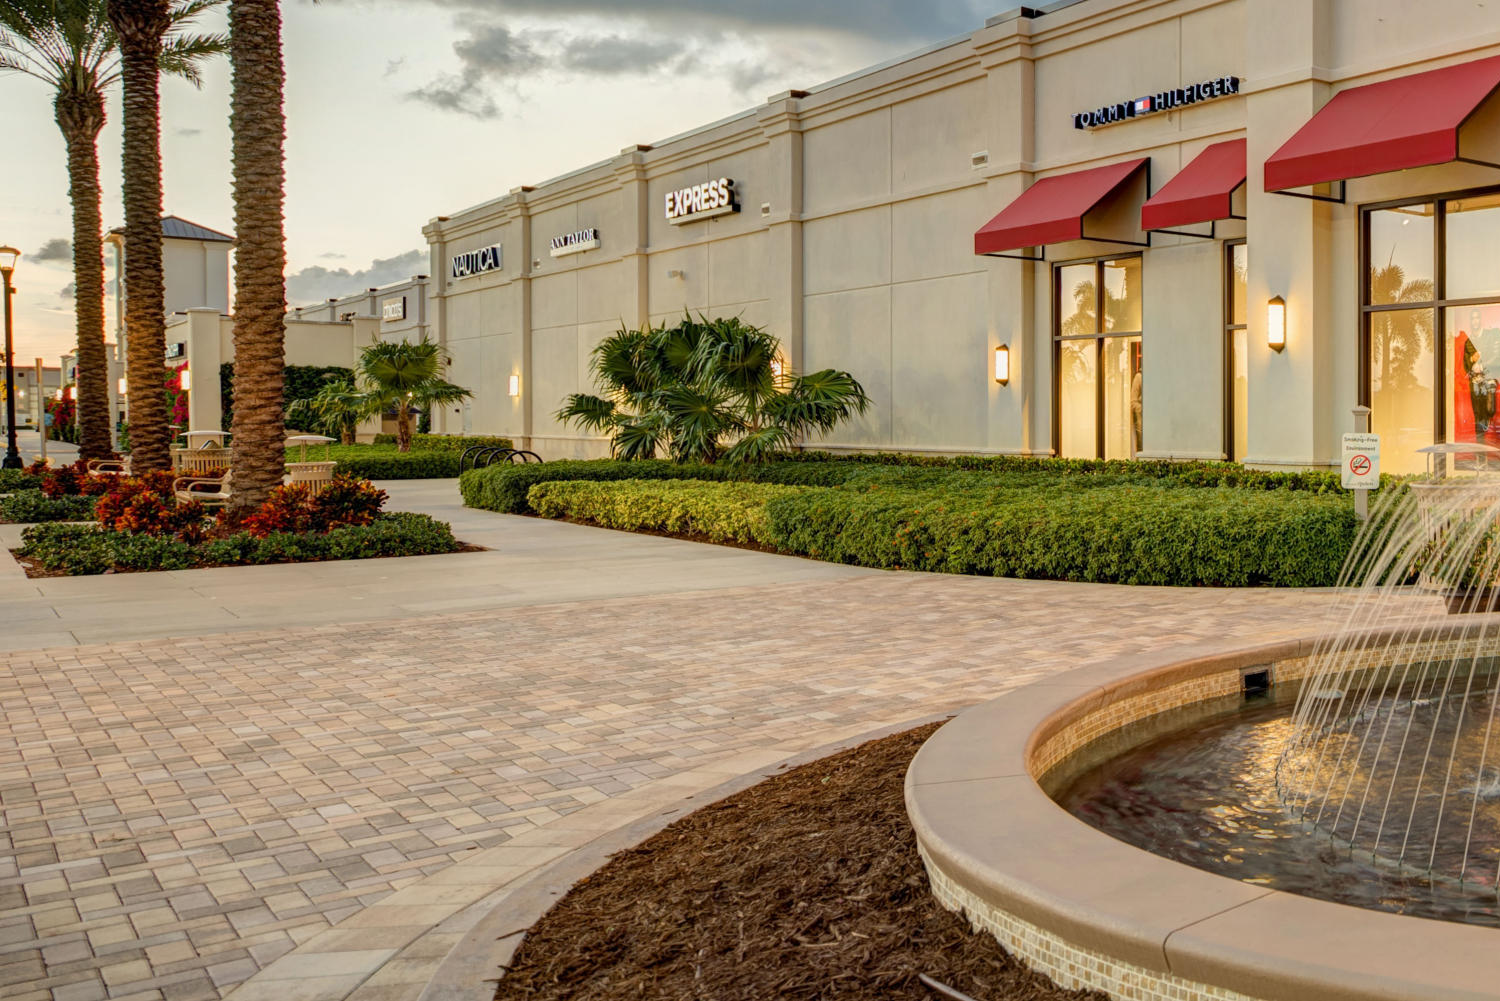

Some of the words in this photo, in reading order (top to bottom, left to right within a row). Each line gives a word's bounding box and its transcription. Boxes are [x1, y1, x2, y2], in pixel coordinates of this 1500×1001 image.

[1071, 100, 1134, 129] TOMMY
[1154, 76, 1240, 111] HILFIGER
[664, 177, 731, 219] EXPRESS
[566, 227, 595, 246] TAYLOR
[452, 246, 498, 278] NAUTICA
